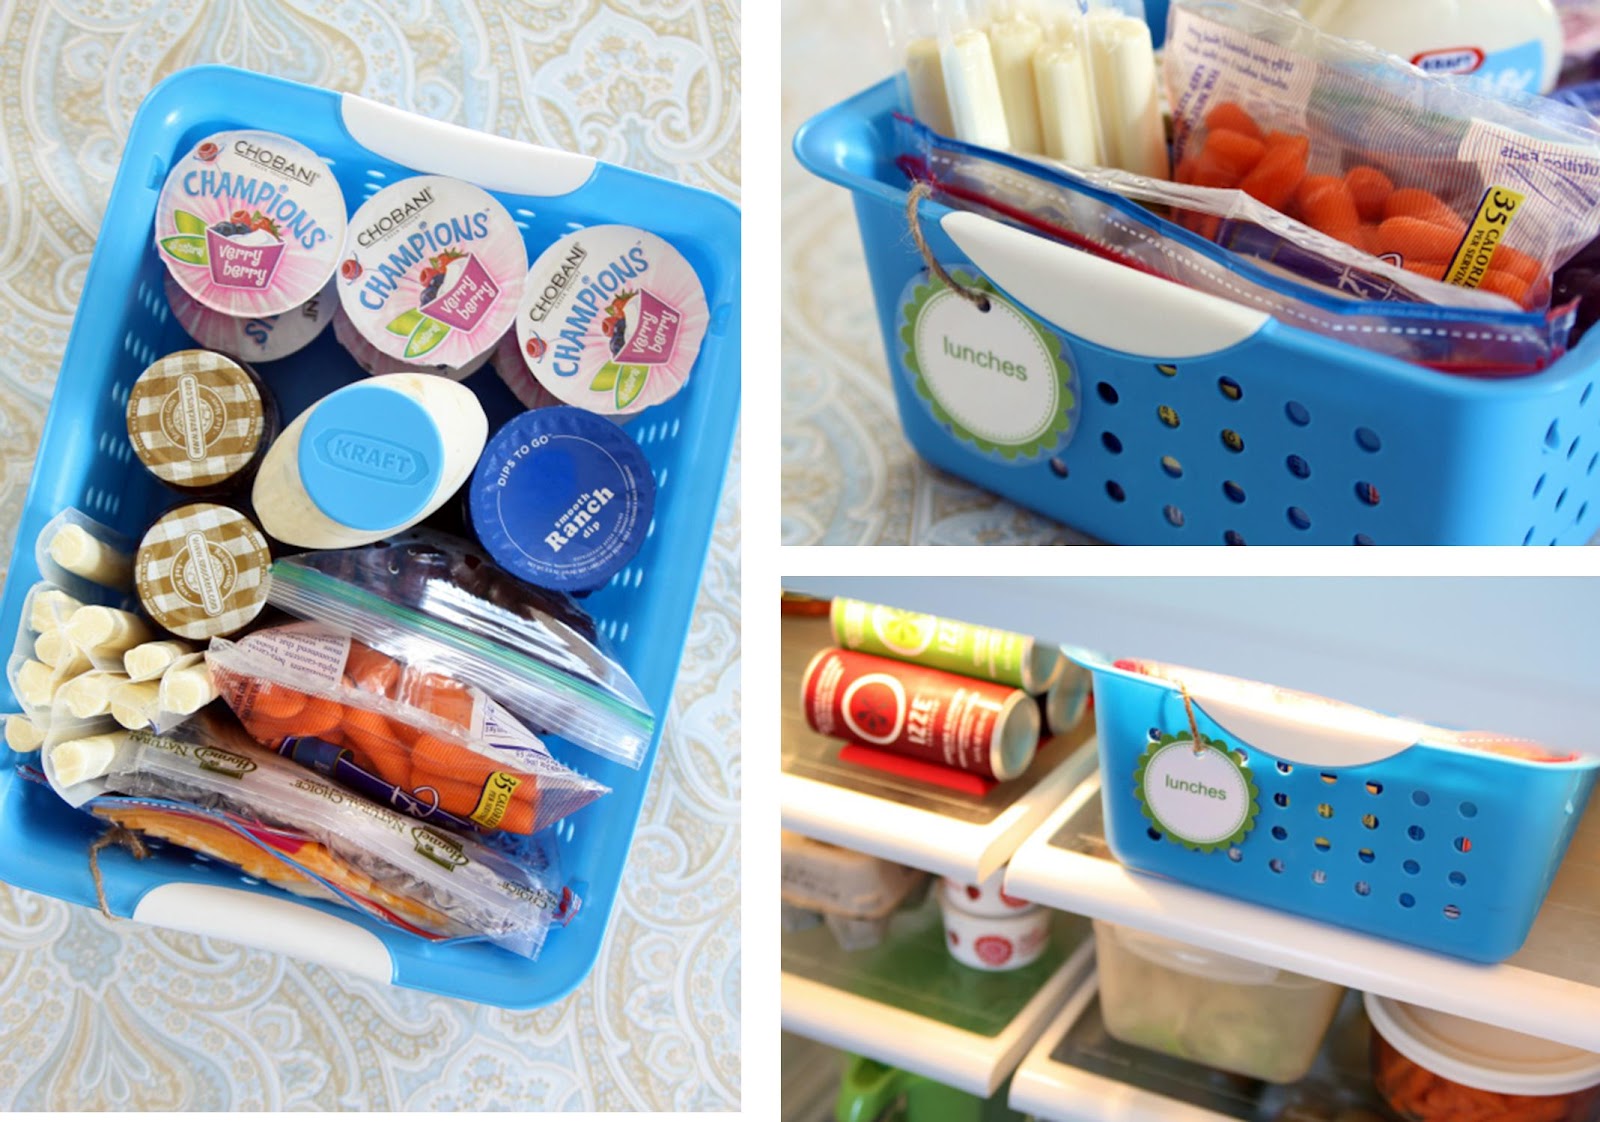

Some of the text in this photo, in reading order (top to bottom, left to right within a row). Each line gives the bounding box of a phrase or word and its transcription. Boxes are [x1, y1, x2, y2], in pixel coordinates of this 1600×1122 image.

[234, 140, 318, 186] CHOBANI
[357, 188, 433, 248] CHOBANI
[1486, 191, 1515, 225] 35
[223, 260, 267, 285] berry
[1452, 248, 1476, 286] SERVIN
[1462, 229, 1499, 288] CALORIE
[456, 281, 497, 322] berry
[529, 246, 586, 323] CHOBANI
[649, 310, 678, 354] berry
[943, 335, 1028, 381] lunches
[334, 440, 412, 475] KRAFT
[497, 435, 549, 487] DIPS TO GO
[544, 487, 615, 552] Ranch
[554, 493, 590, 529] smooth
[582, 520, 601, 539] dip
[908, 693, 934, 745] IZZE
[201, 749, 250, 769] Hormel
[295, 780, 343, 804] CHOICE
[494, 772, 516, 793] 35
[1165, 773, 1226, 801] lunches
[346, 799, 406, 834] NATURAL
[419, 829, 463, 862] Hormel
